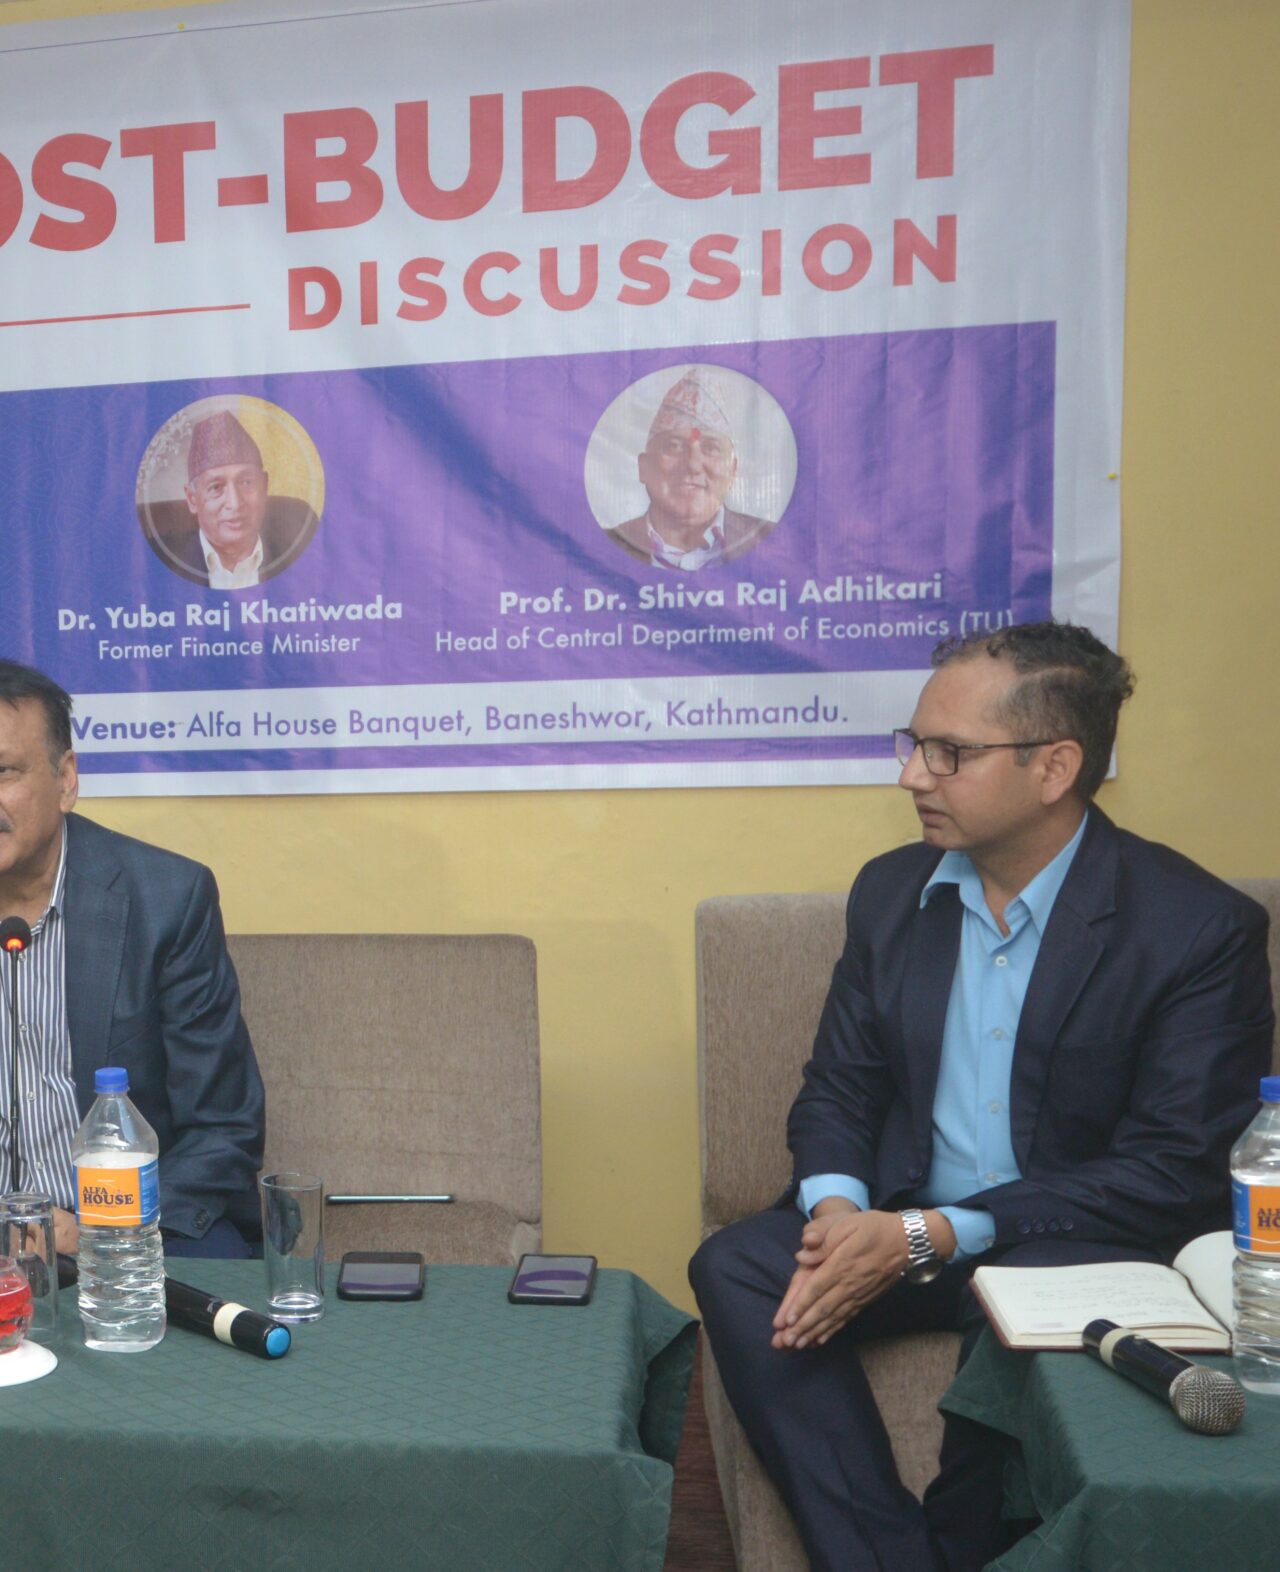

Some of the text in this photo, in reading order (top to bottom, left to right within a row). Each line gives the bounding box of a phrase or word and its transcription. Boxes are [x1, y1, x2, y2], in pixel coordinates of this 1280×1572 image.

[288, 213, 958, 332] DISCUSSION
[499, 572, 943, 615] Prof. Dr. Shiva Raj Adhikari
[57, 594, 404, 632] Dr. Yuba Raj Khatiwada
[98, 632, 361, 660] Former Finance Minister
[435, 627, 498, 652] Head
[506, 626, 531, 650] of
[537, 623, 623, 648] Central
[632, 619, 776, 650] Department
[783, 616, 810, 641] of
[817, 614, 950, 640] Economics
[70, 695, 849, 741] Venue: Alfa House Banquet, Baneshwor, Kathmandu.
[82, 1186, 108, 1195] ALFA
[82, 1193, 135, 1206] HOUSE
